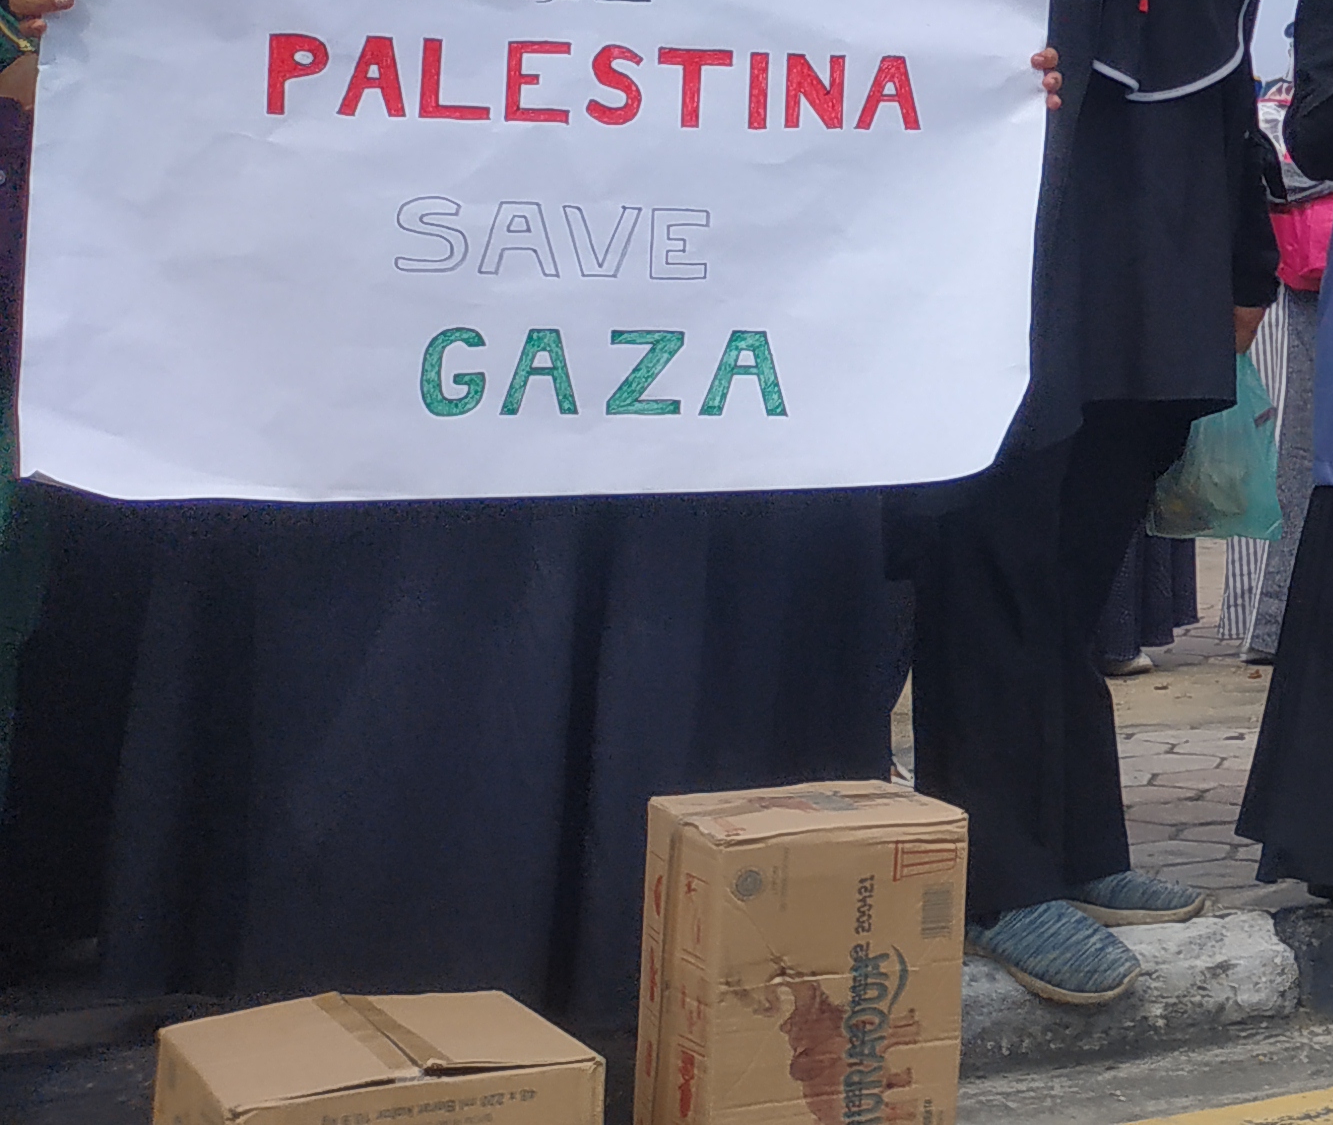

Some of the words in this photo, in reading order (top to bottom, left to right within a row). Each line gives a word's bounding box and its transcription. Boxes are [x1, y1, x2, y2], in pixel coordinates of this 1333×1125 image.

[265, 32, 922, 132] PALESTINA
[393, 195, 712, 282] SAVE
[419, 326, 789, 420] GAZA
